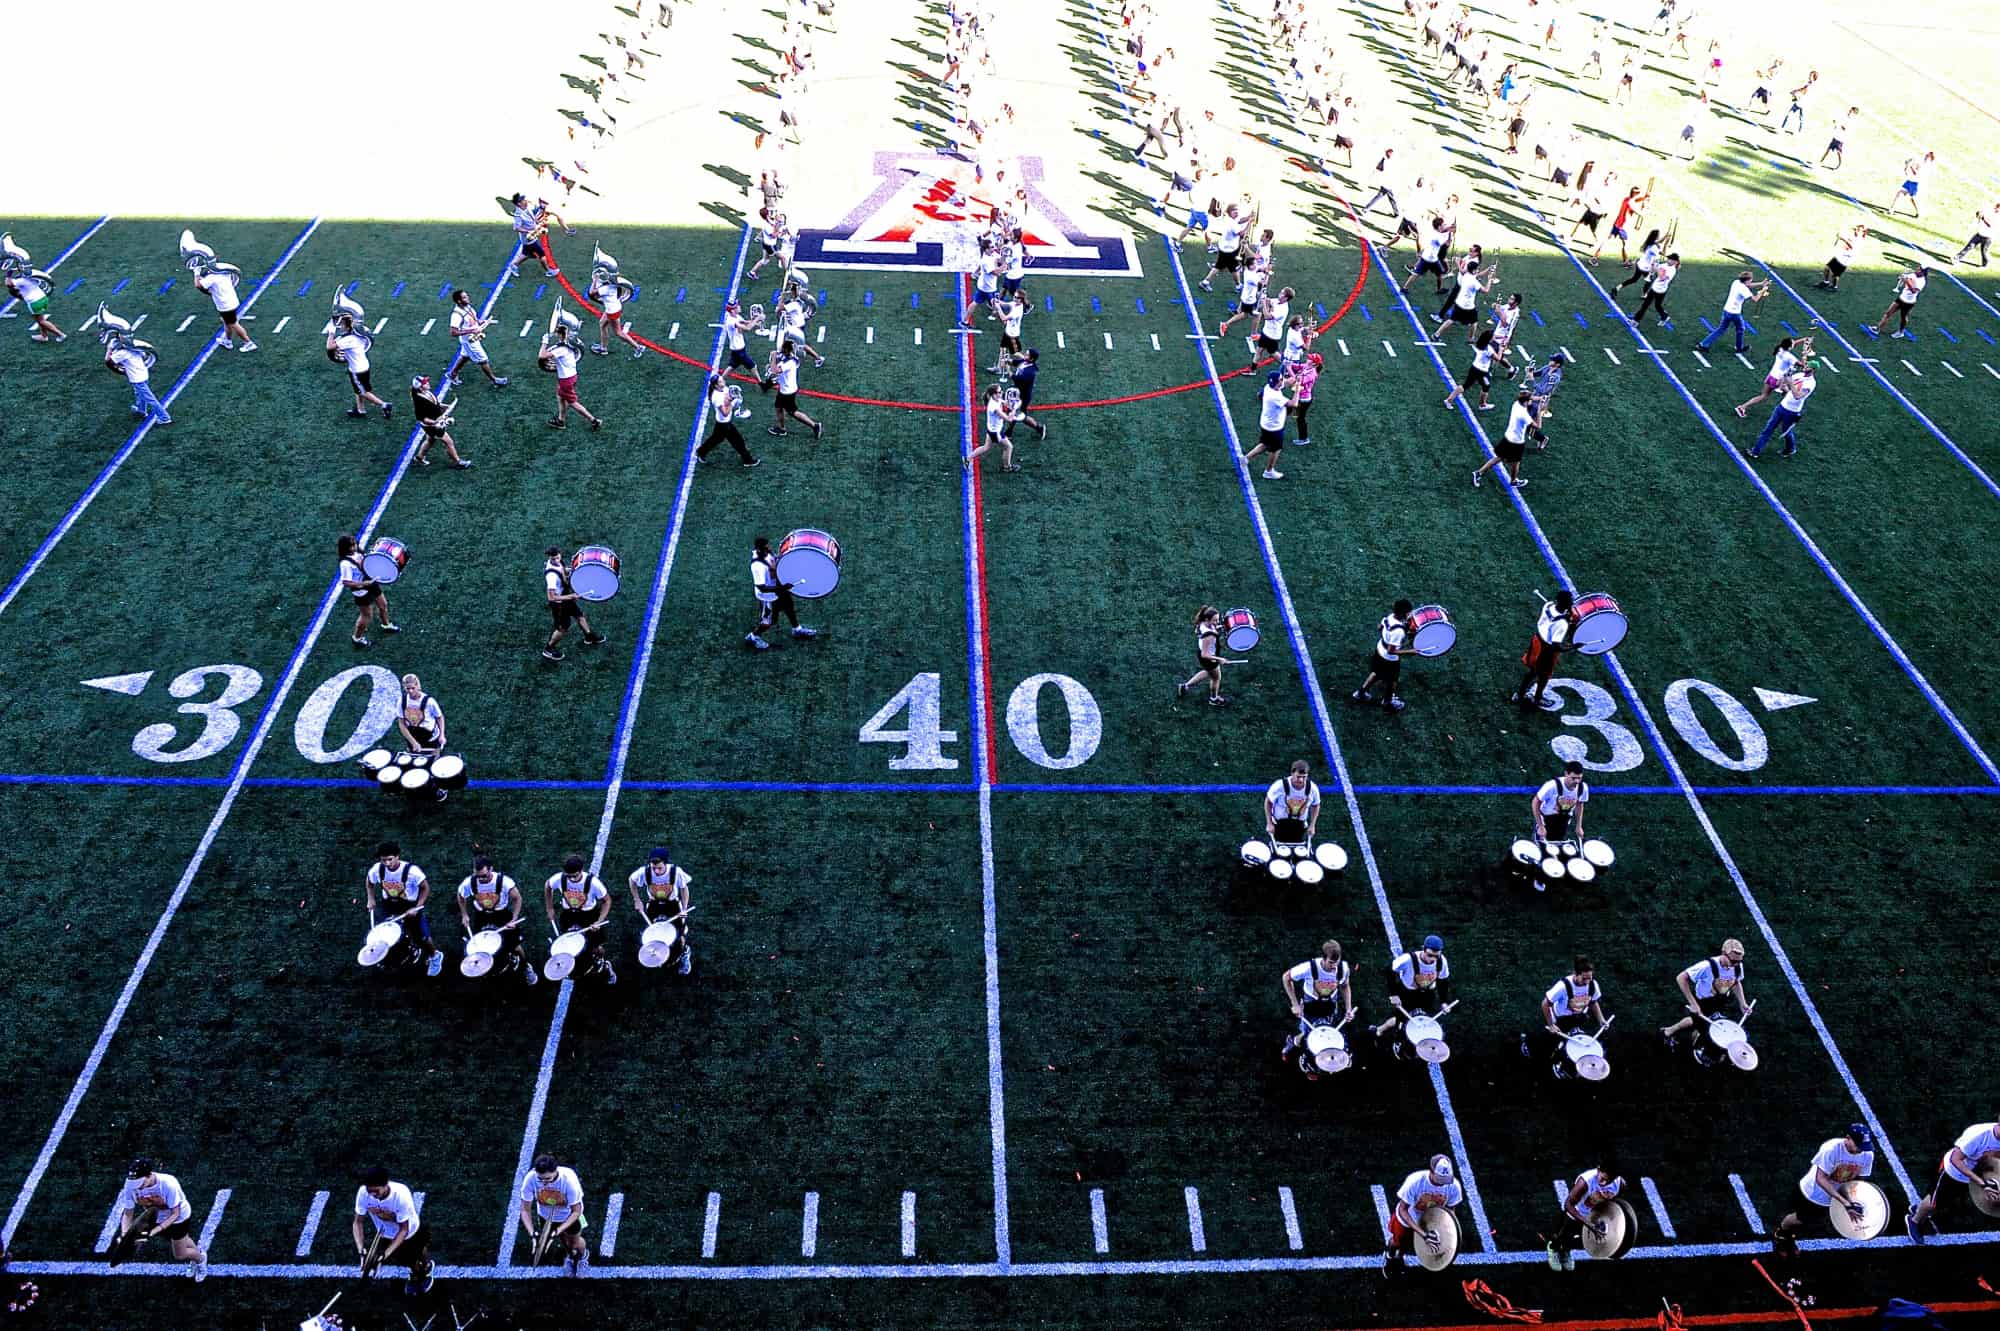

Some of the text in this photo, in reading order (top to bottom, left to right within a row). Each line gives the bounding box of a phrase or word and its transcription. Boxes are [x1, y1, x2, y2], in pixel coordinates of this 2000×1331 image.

[131, 663, 404, 764] 30
[859, 672, 1104, 770] 40
[1527, 677, 1769, 773] 30
